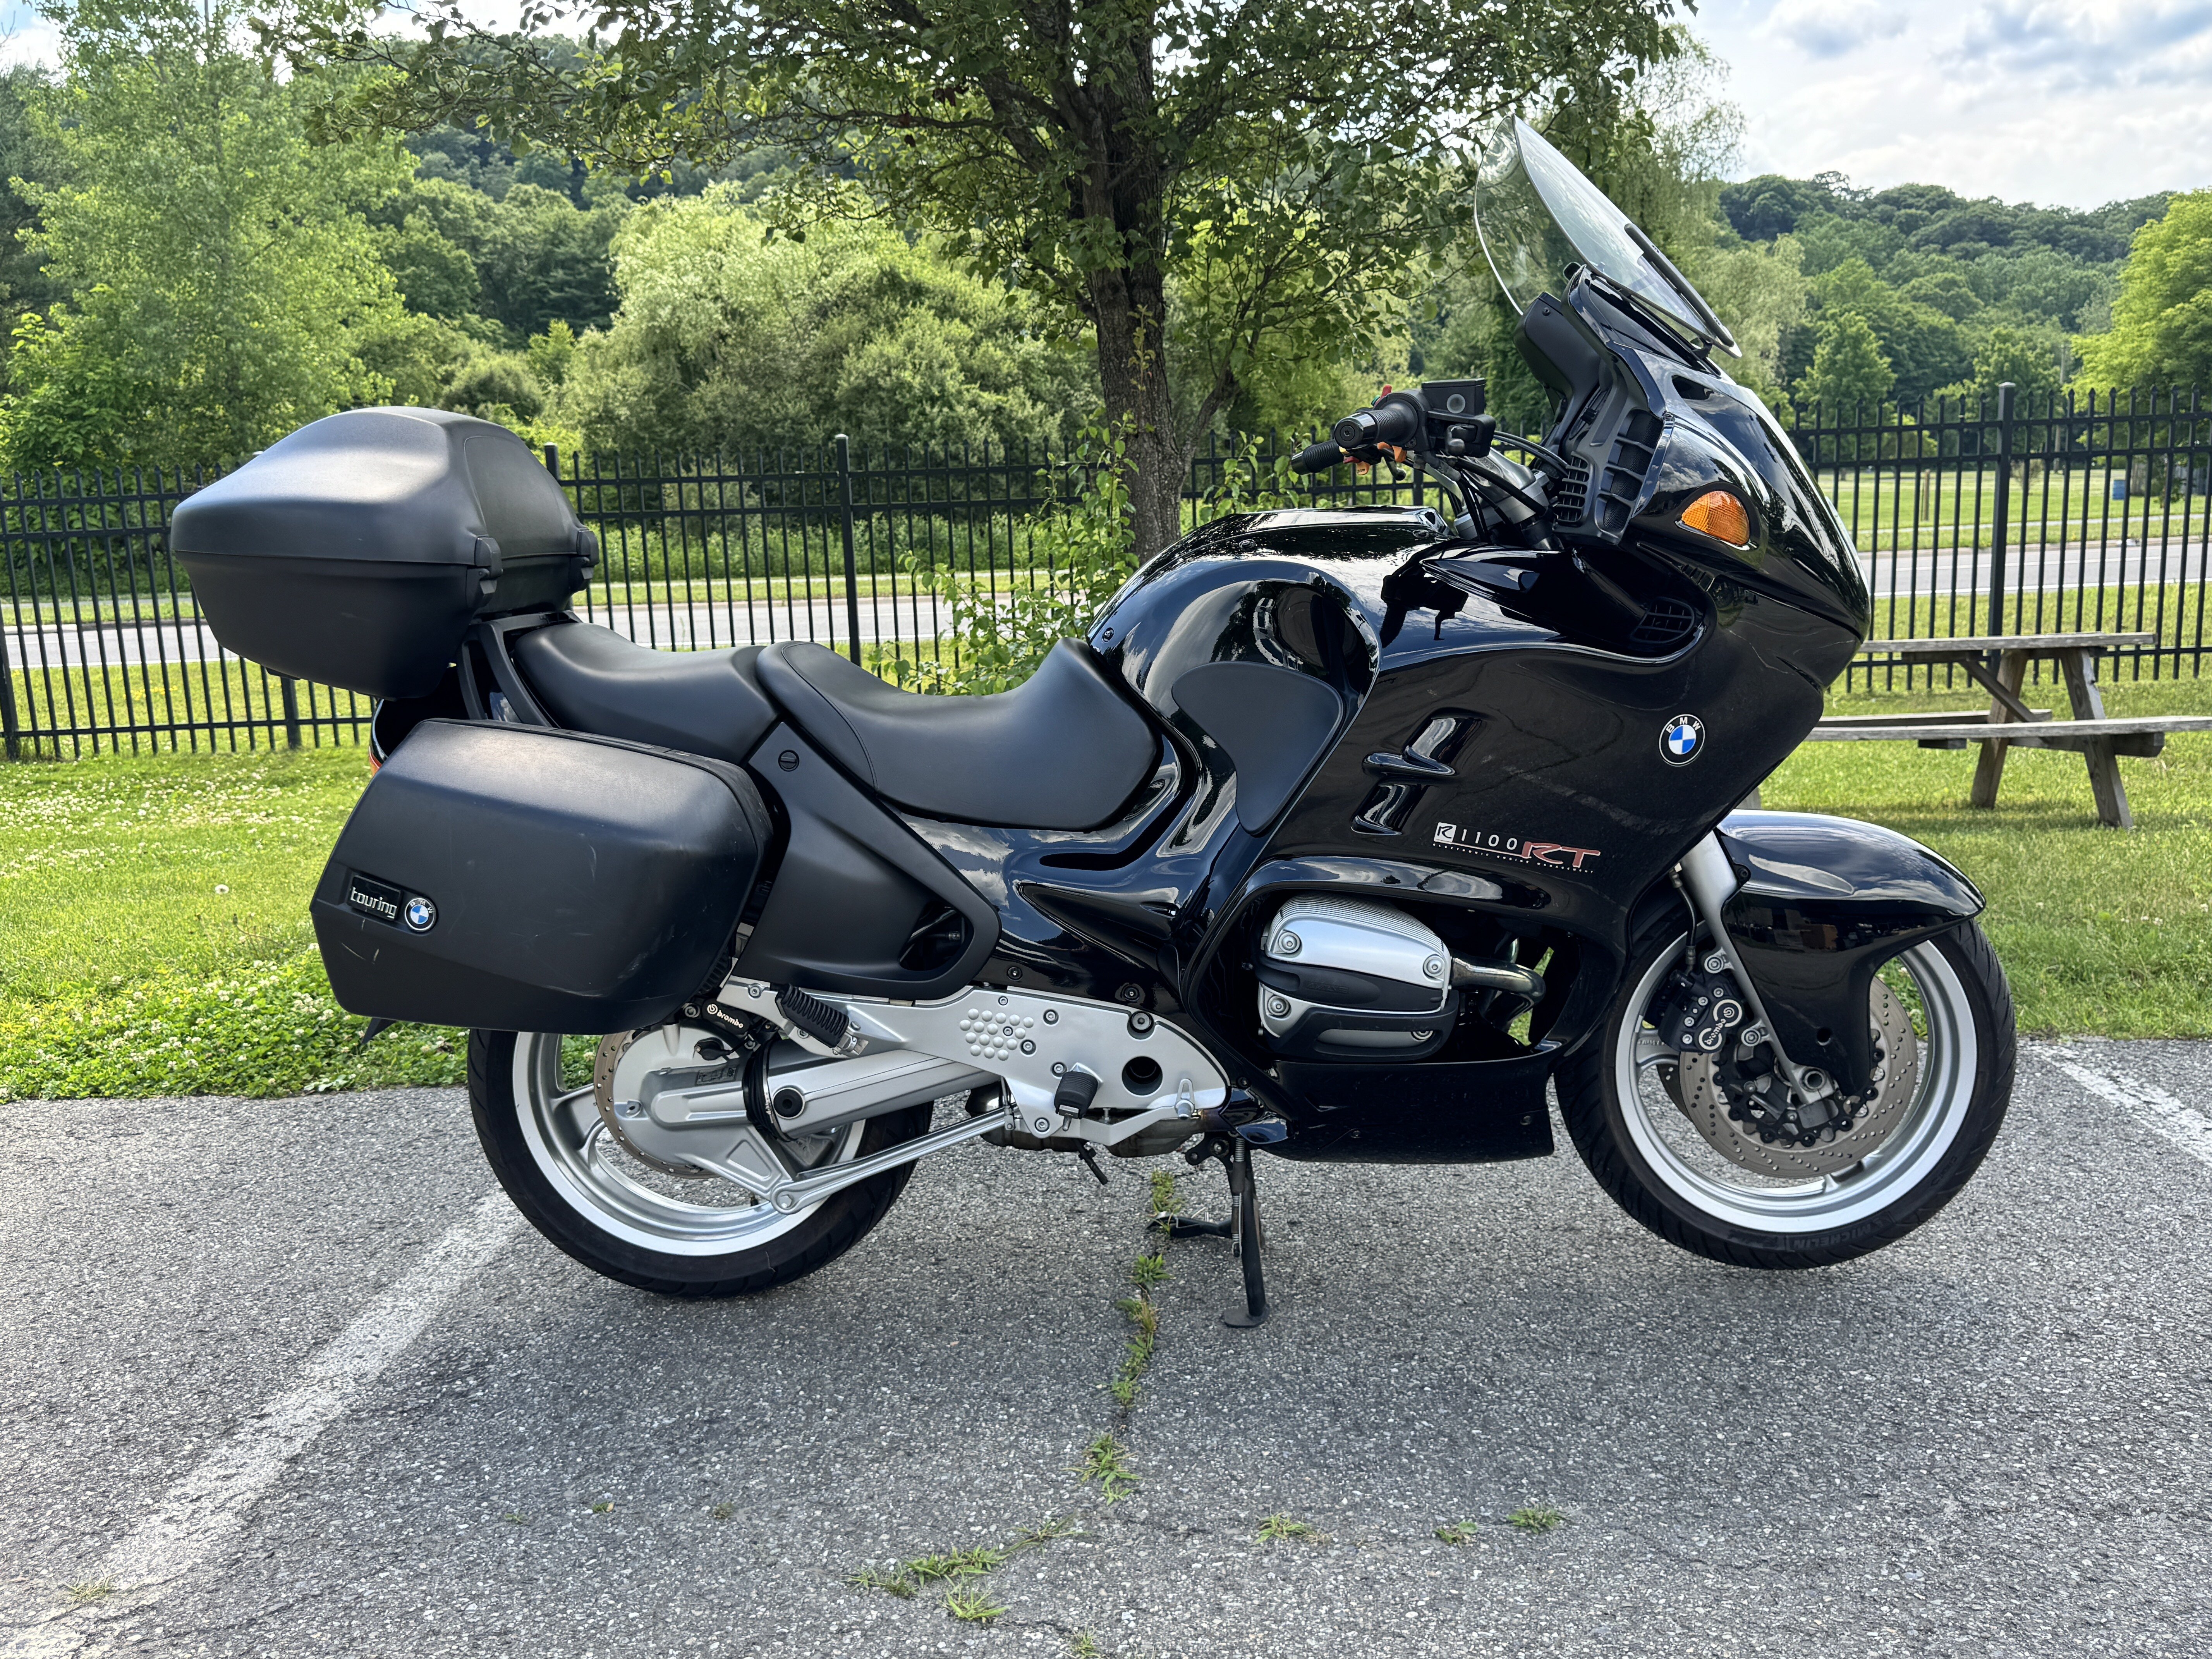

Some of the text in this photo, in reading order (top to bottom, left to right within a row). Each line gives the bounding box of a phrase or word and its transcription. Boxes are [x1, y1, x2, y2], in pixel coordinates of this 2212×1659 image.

[1666, 716, 1701, 733] BMW
[1522, 841, 1601, 868] RT
[350, 887, 397, 919] touring
[410, 901, 434, 913] BMW
[716, 1010, 744, 1028] brembo
[1704, 1018, 1726, 1045] brembo
[1793, 1223, 1871, 1248] MICHELIN
